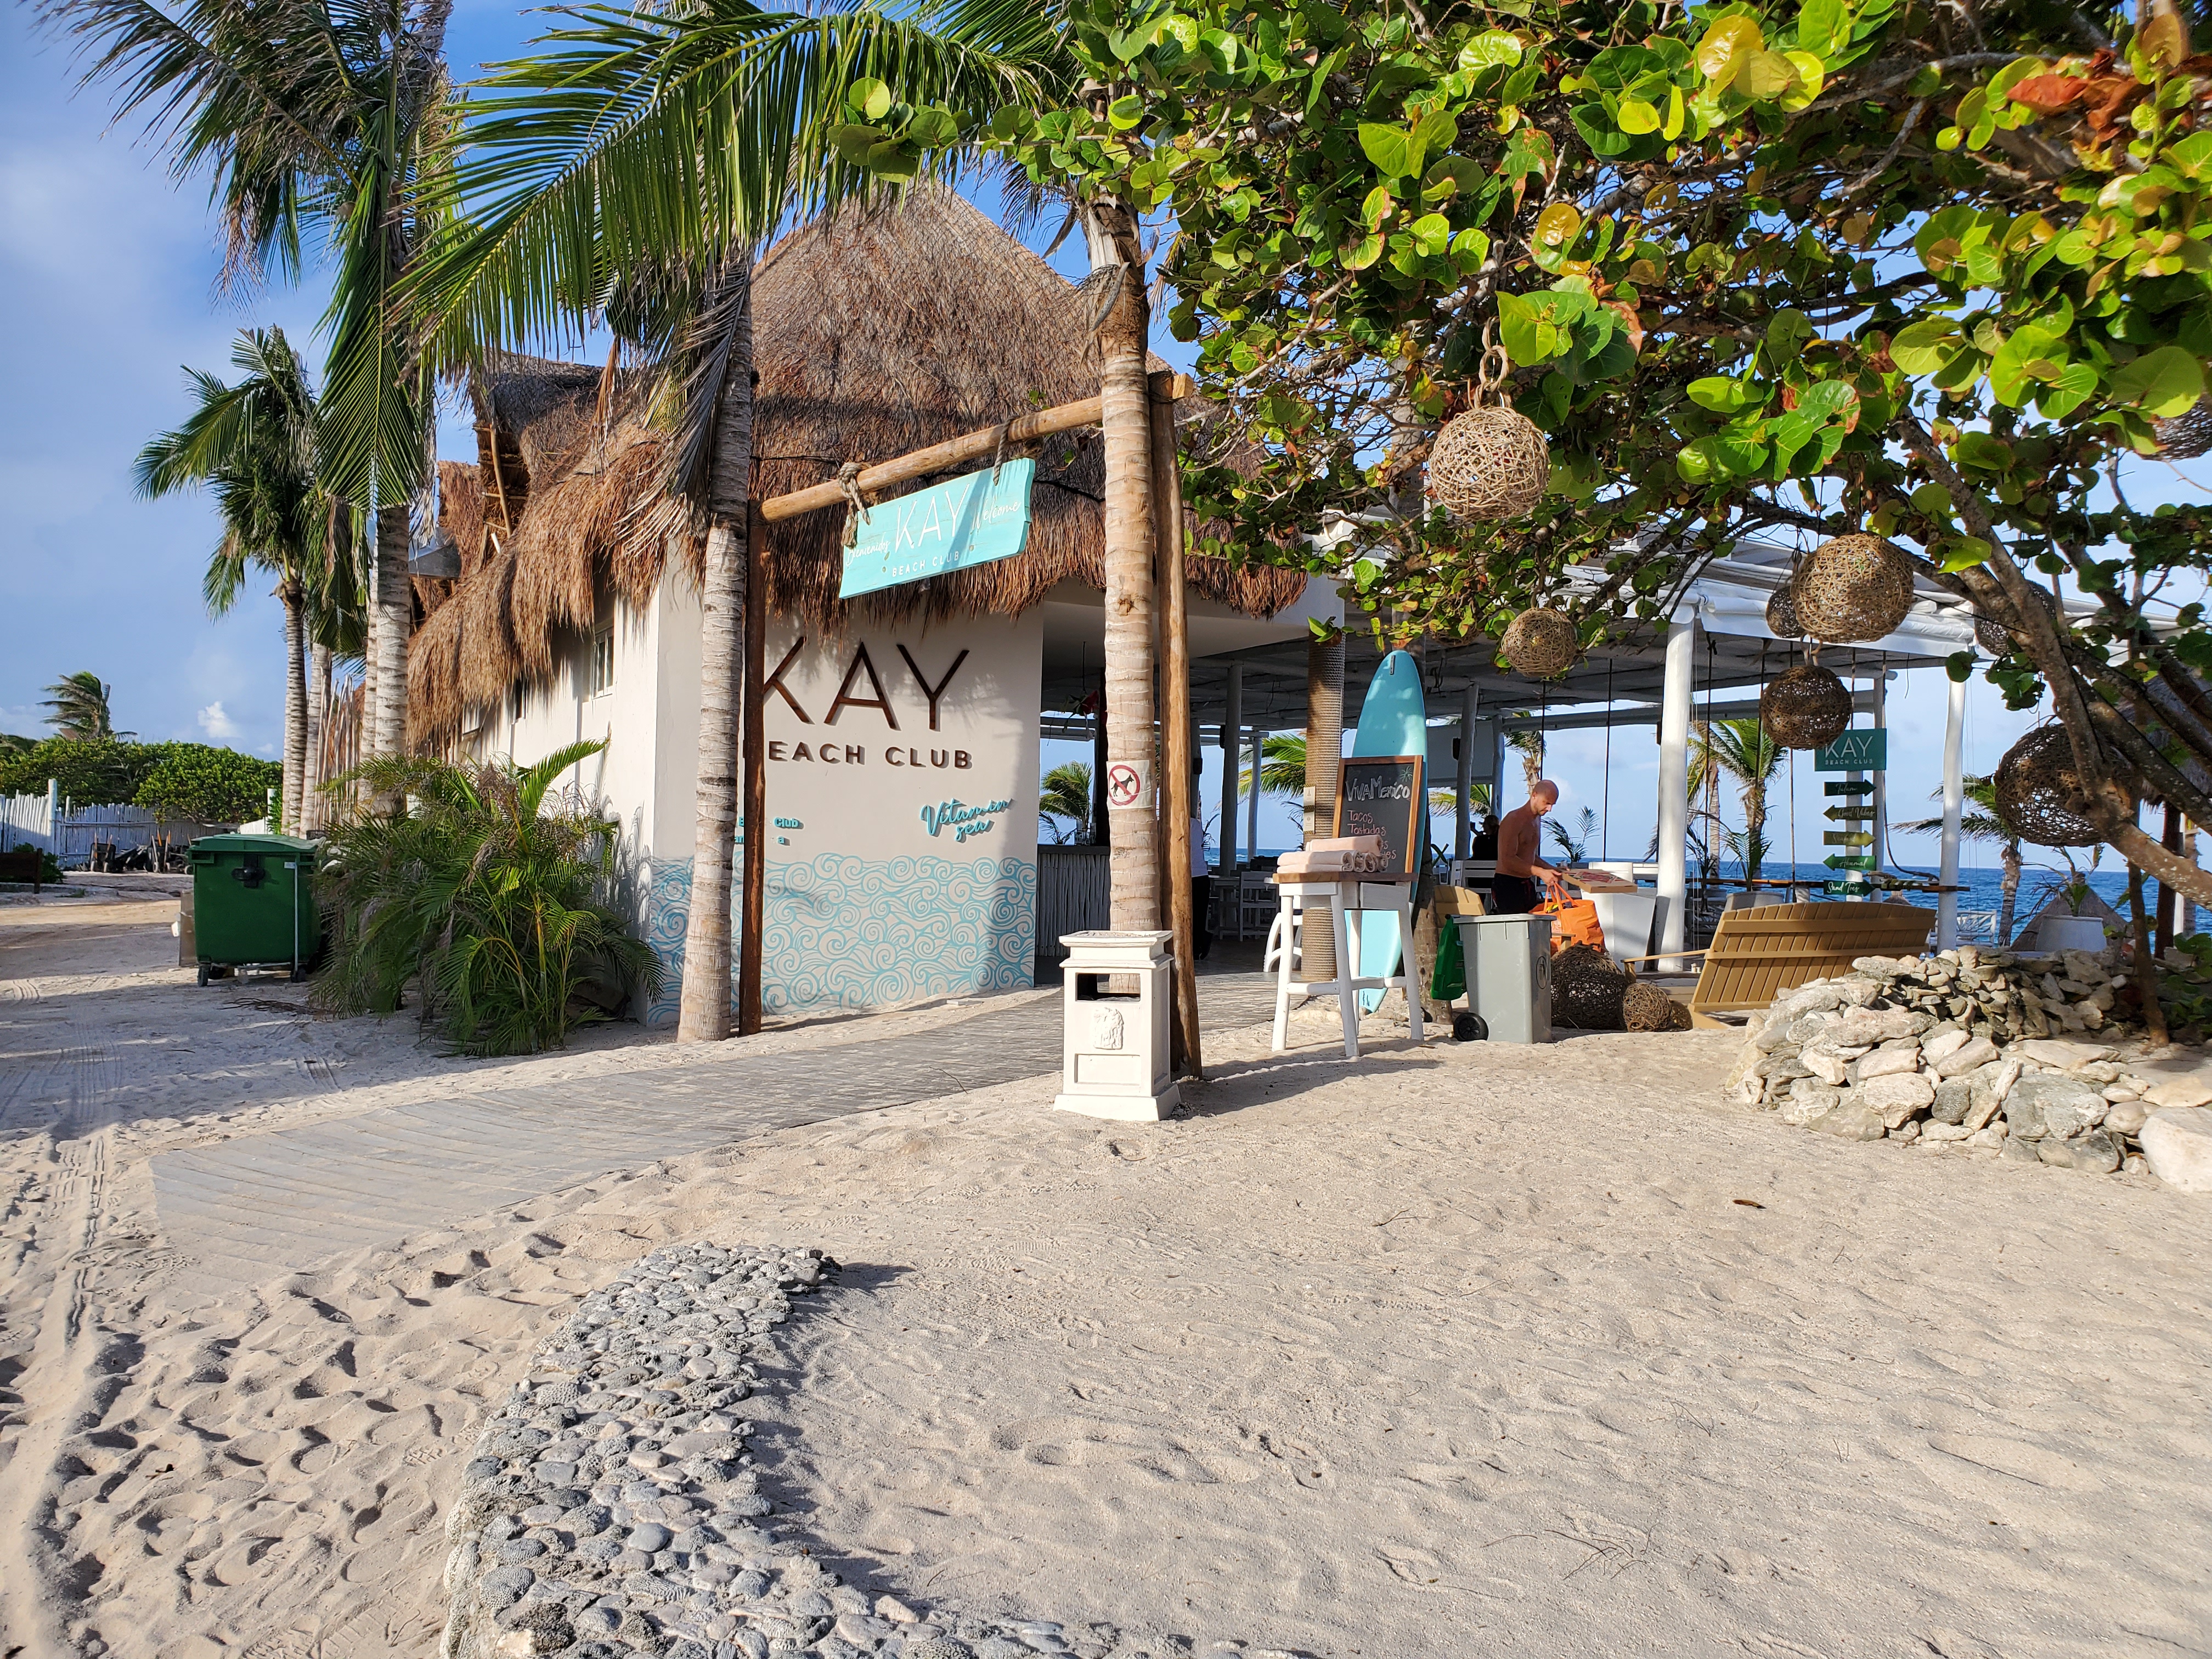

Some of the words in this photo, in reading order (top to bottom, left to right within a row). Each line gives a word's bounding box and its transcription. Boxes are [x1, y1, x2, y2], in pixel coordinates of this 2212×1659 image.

[895, 483, 970, 554] KAY
[971, 494, 1022, 531] Welcome
[892, 559, 926, 577] BEACH
[932, 550, 959, 567] CLUB
[743, 740, 862, 764] EACH
[885, 746, 970, 769] CLUB
[1825, 736, 1874, 758] KAY
[919, 798, 1013, 836] Vitamin
[955, 819, 991, 842] sea
[1347, 810, 1373, 824] Tacos
[1827, 881, 1844, 894] Sand
